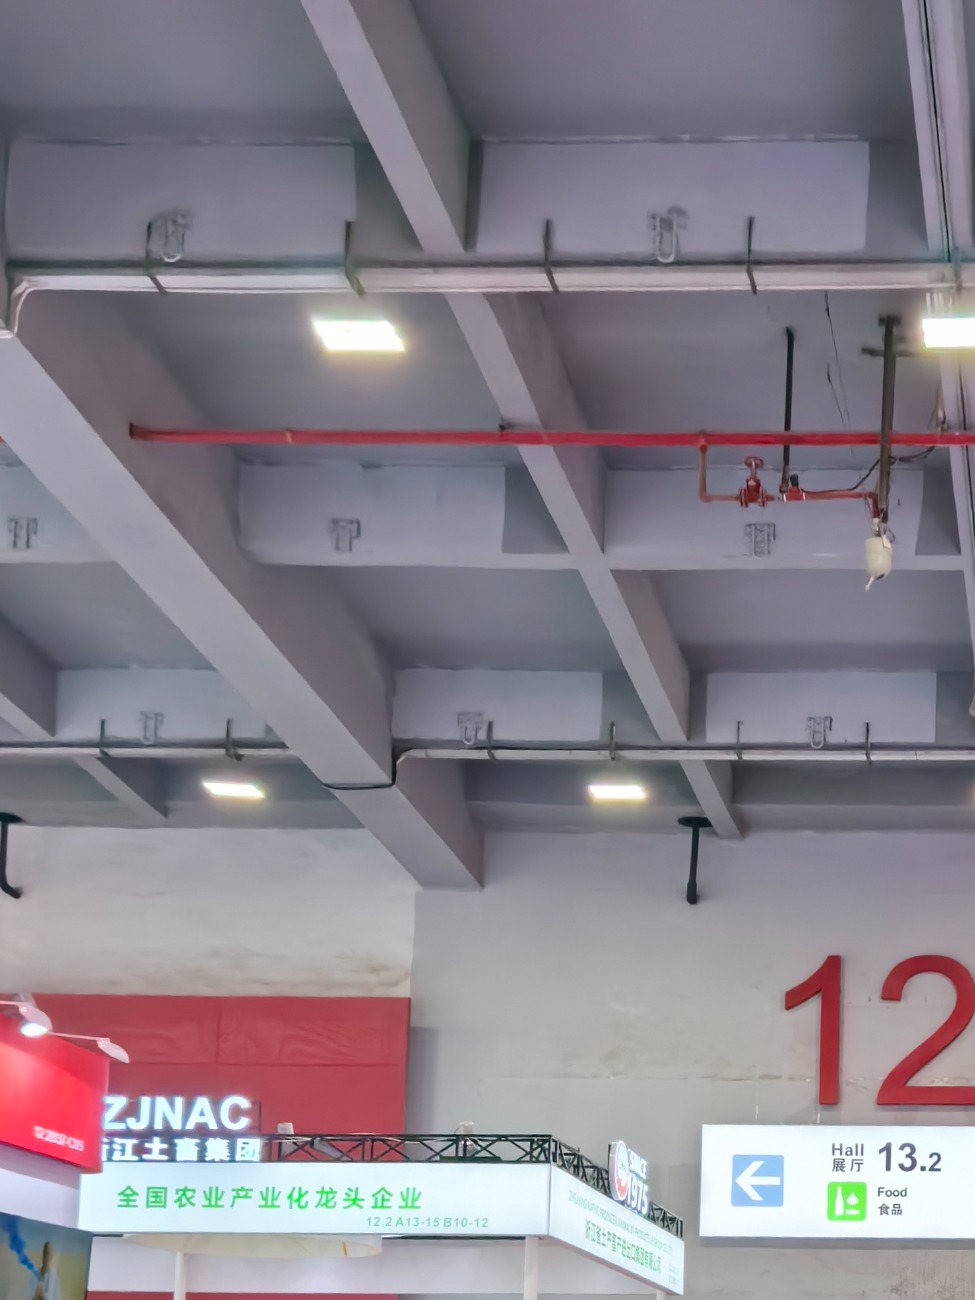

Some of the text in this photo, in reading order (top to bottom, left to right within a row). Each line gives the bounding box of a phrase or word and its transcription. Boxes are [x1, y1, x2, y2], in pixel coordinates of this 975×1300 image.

[103, 1096, 251, 1130] ZJNAC
[832, 1142, 942, 1172] Hall 13.2
[832, 1158, 864, 1173] 展厅
[117, 1185, 422, 1210] 全国农业产业化龙头企业
[627, 1175, 648, 1214] 1975
[877, 1187, 907, 1198] Food
[878, 1203, 903, 1216] 食品
[366, 1216, 488, 1228] 12.2 A13-15 B10-12
